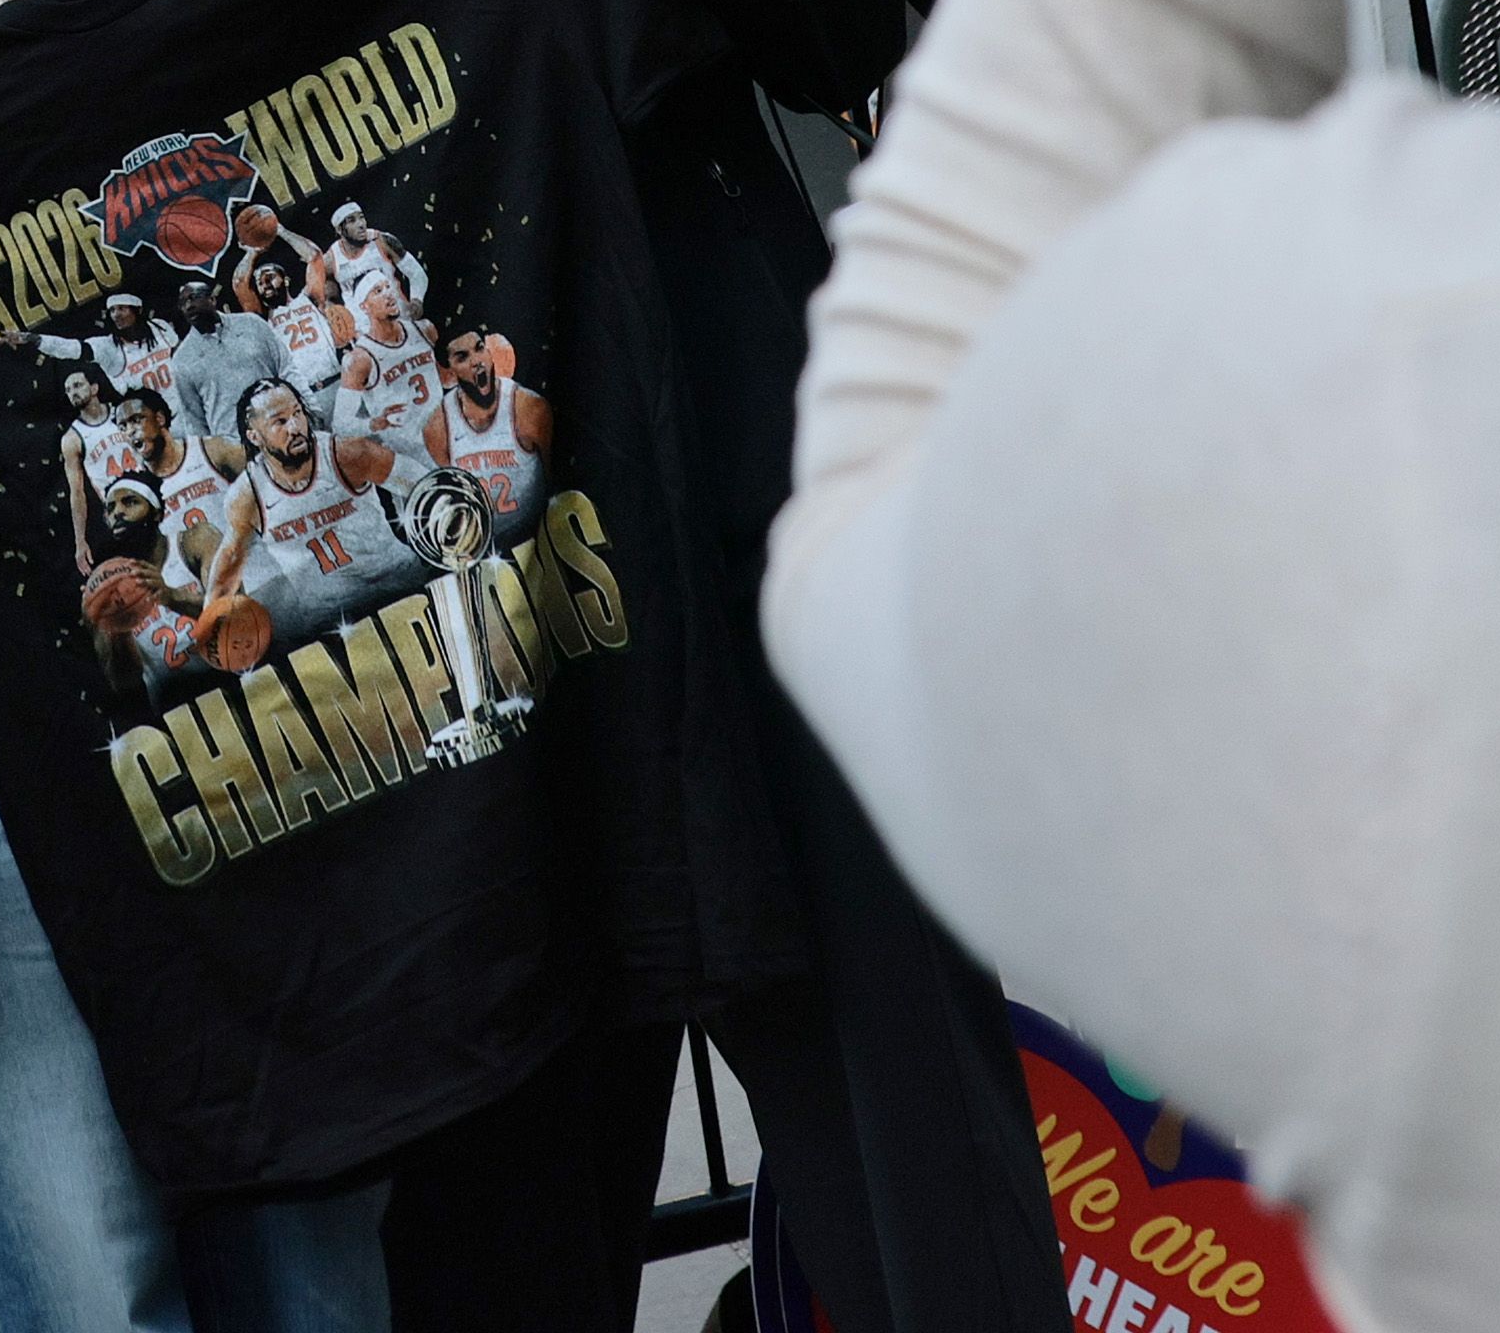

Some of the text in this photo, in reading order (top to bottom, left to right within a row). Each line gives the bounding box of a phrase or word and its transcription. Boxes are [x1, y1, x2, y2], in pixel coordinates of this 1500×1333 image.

[224, 22, 457, 211] WORLD
[125, 136, 187, 173] NEW YORK
[104, 136, 258, 247] KNICKS
[284, 317, 319, 352] 25
[408, 373, 430, 406] 3
[106, 446, 138, 478] 44
[269, 514, 310, 543] NEW
[305, 529, 353, 575] 11
[109, 490, 629, 887] CHAMPONS
[1036, 1114, 1265, 1316] We are
[1066, 1253, 1222, 1333] HEA
